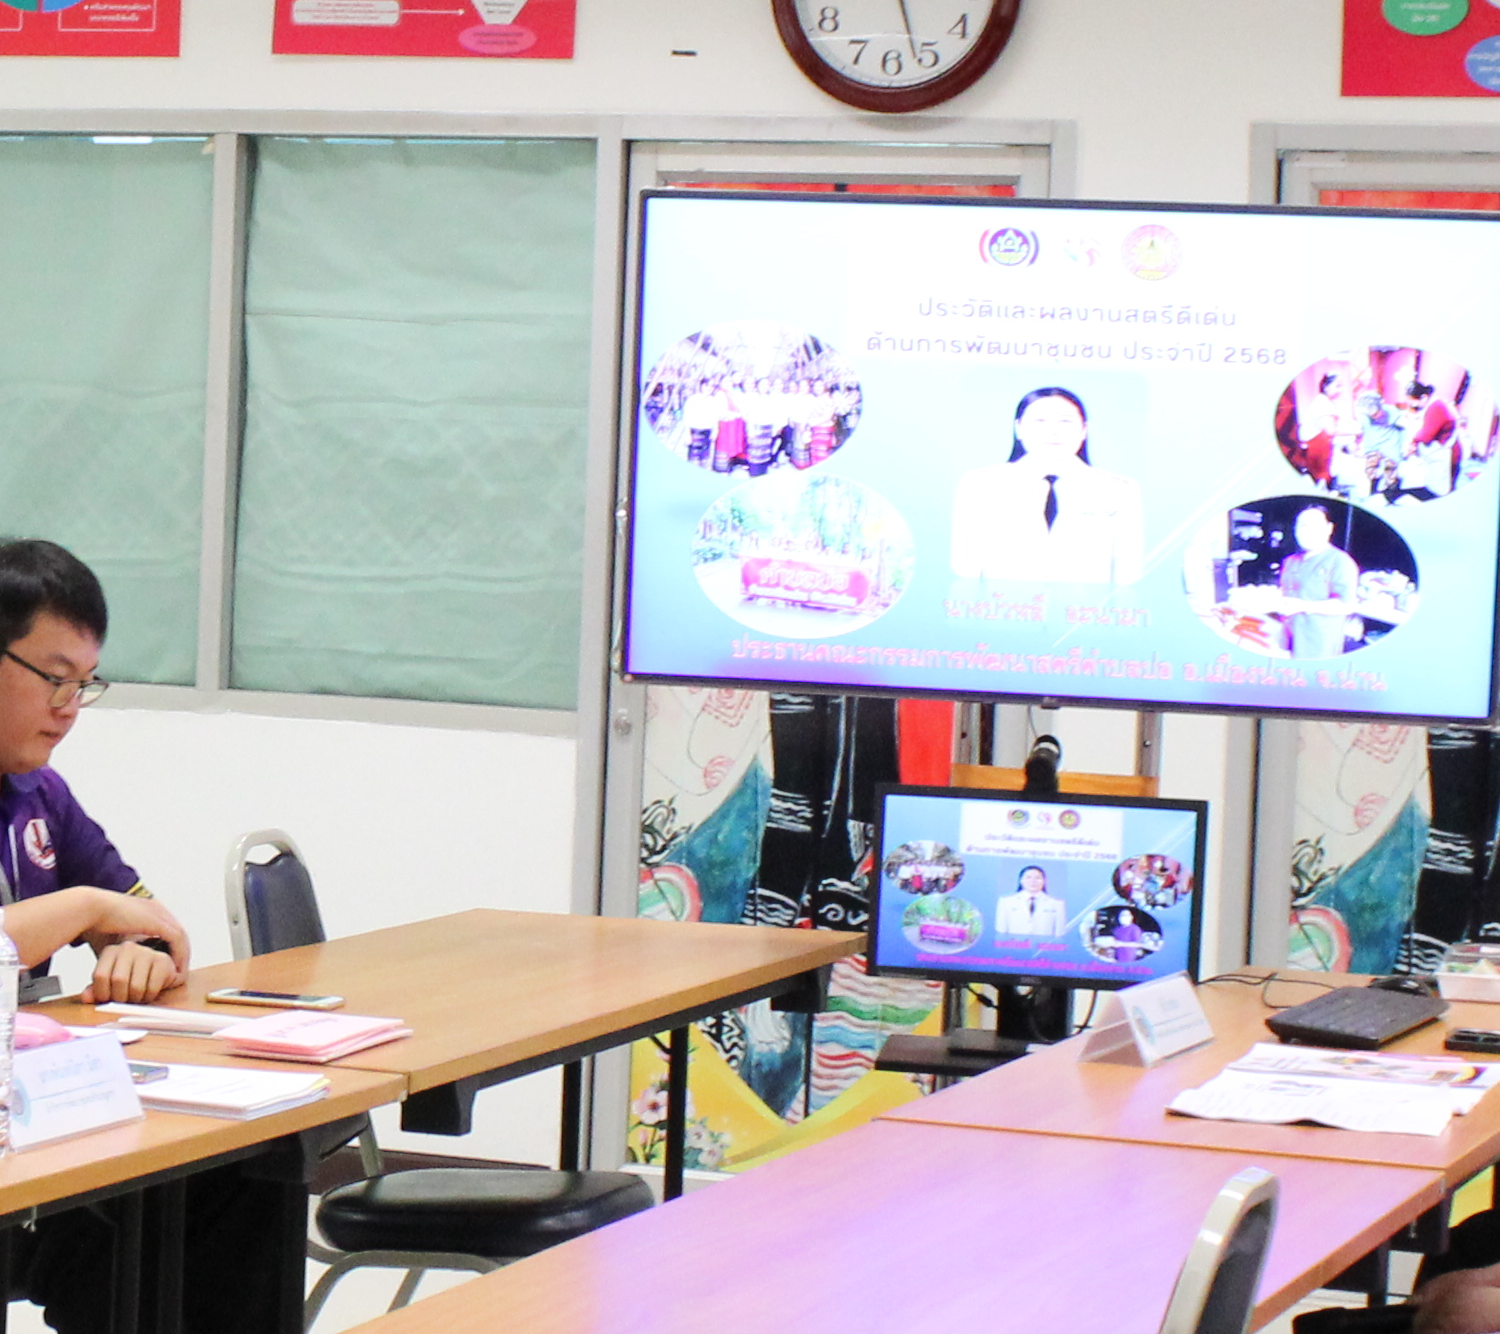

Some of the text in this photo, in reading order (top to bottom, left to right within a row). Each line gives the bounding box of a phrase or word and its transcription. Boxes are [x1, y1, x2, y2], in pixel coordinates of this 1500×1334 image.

[818, 7, 840, 32] 8
[947, 14, 969, 39] 4
[848, 40, 868, 65] 7
[881, 50, 903, 76] 6
[917, 42, 939, 68] 5
[918, 296, 1237, 327] ประวัติและผลงานสตรีดีเด่น
[866, 331, 1288, 365] ด้านการพัฒนาชุมชน ประจำปี 2568
